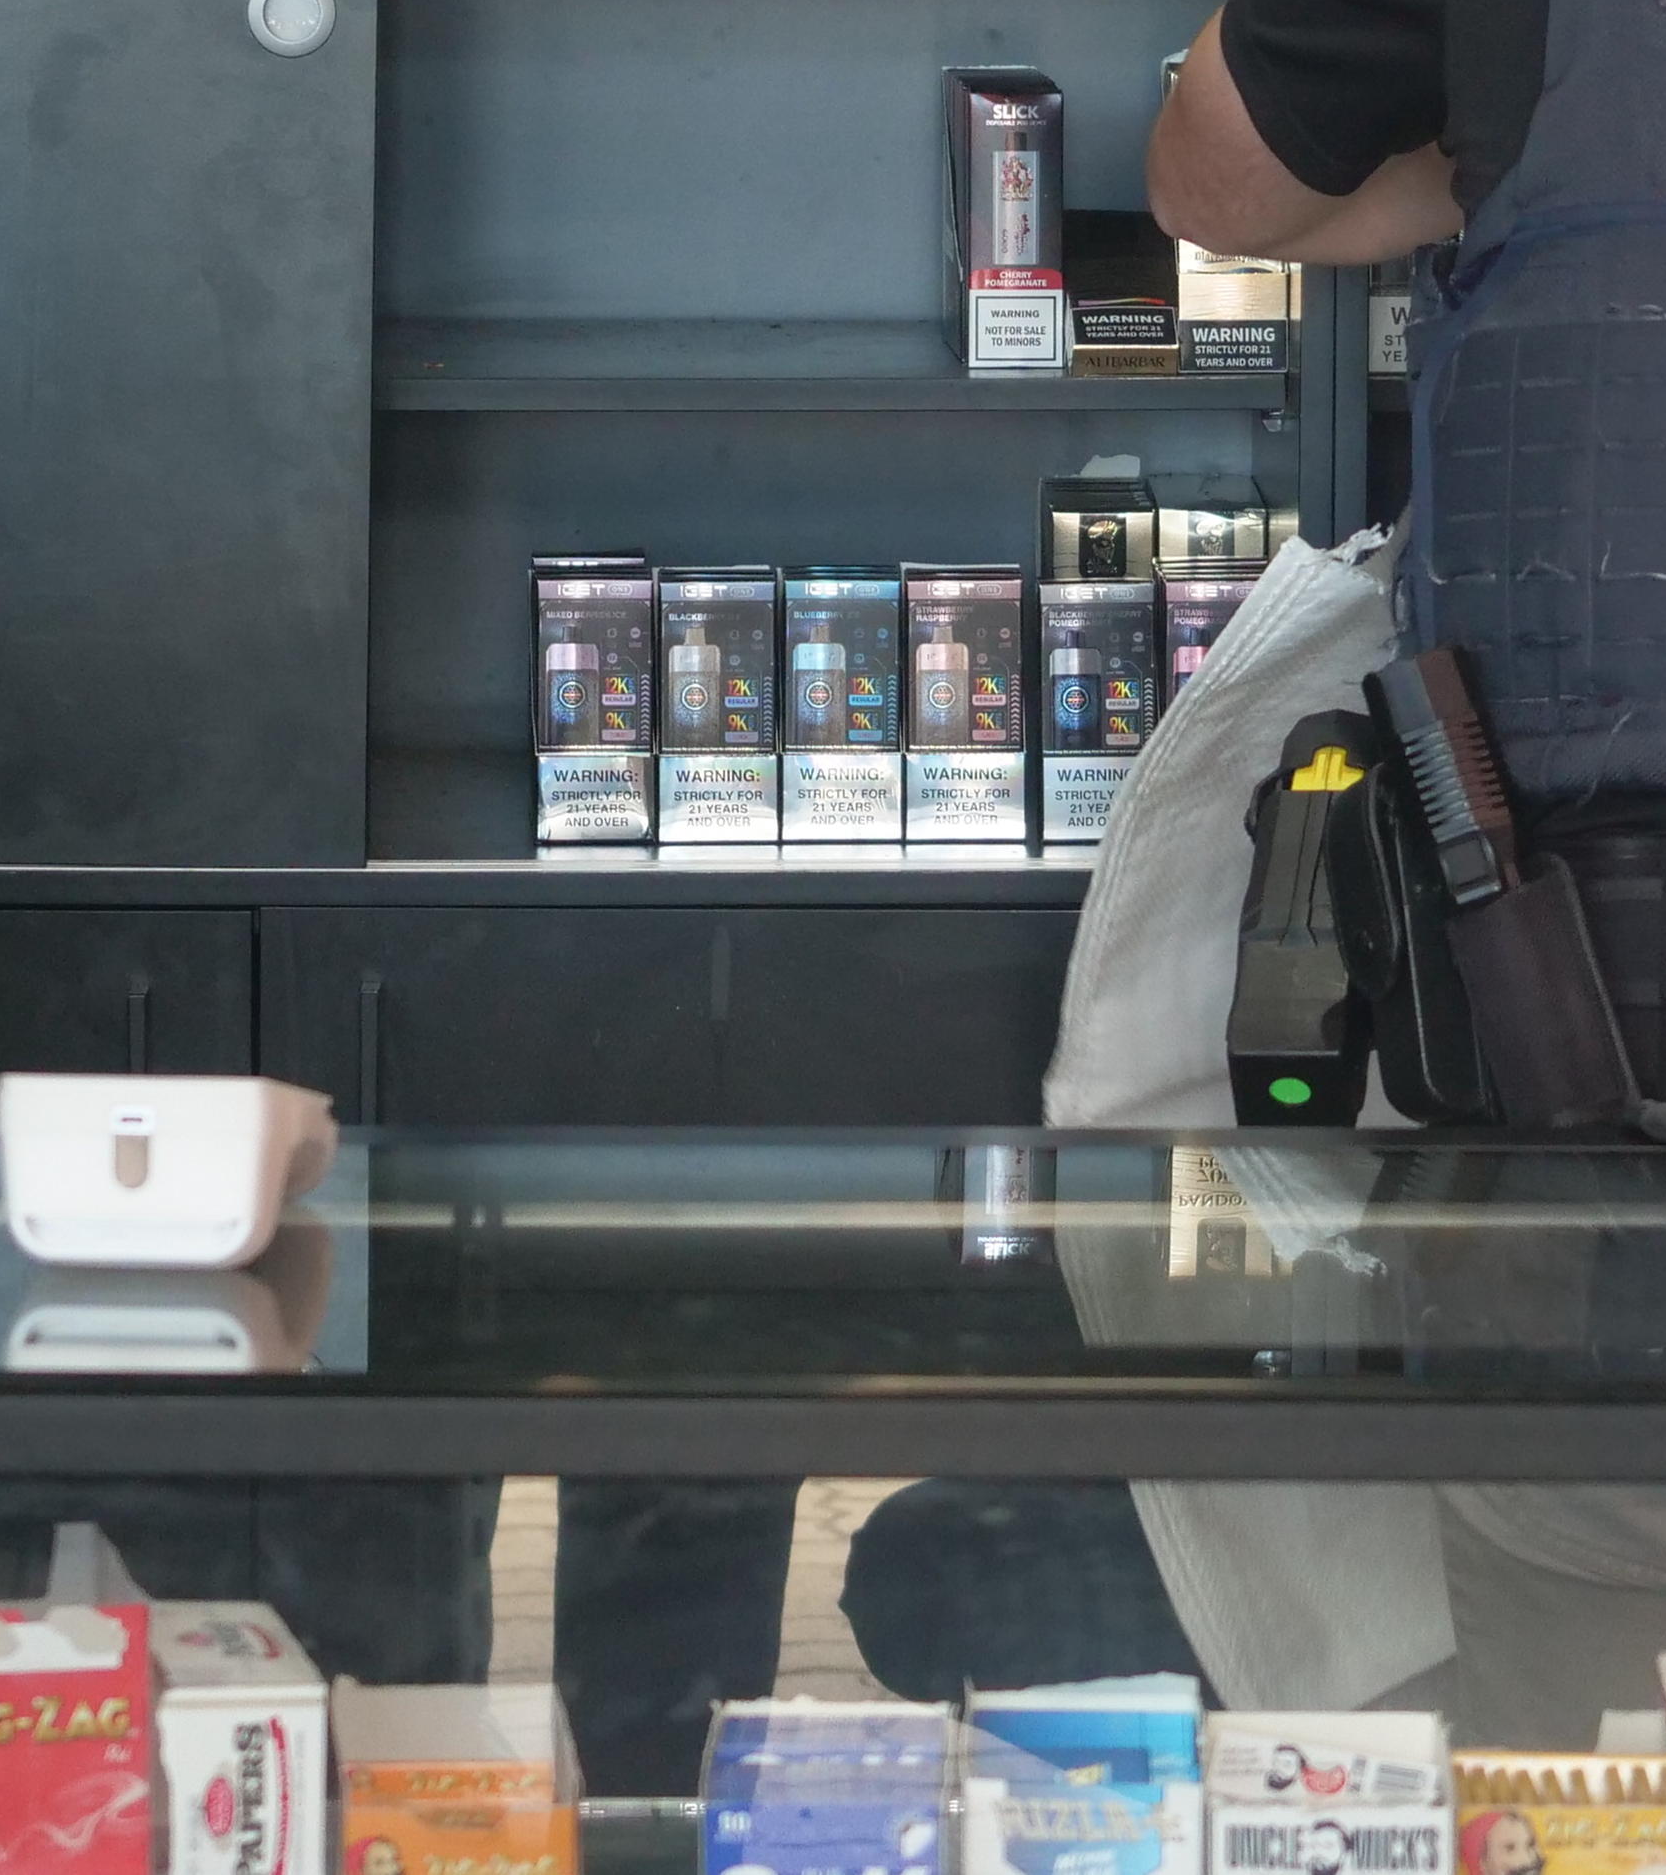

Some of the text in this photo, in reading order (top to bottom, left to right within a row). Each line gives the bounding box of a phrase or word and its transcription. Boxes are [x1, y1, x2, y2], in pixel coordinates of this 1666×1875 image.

[993, 104, 1039, 119] SLICK
[999, 271, 1033, 279] CHERRY
[984, 279, 1048, 287] POMEGRANATE
[990, 310, 1040, 318] WARNING
[1082, 315, 1165, 324] WARNING
[984, 326, 1047, 336] NOT FOR SALE
[1192, 327, 1276, 343] WARNING
[991, 337, 1042, 347] TO MINORS
[1195, 345, 1271, 355] STRICTLY FOR 21
[1195, 358, 1273, 367] YEARS AND OVER
[553, 769, 639, 783] WARNING:
[675, 769, 761, 783] WARNING:
[799, 767, 885, 781] WARNING:
[923, 767, 1008, 782] WARNING:
[551, 790, 642, 802] STRICTLY FOR
[673, 790, 764, 802] STRICTLY FOR
[797, 788, 887, 800] STRICTLY FOR
[921, 788, 1011, 800] STRICTLY FOR
[1055, 789, 1115, 800] STRICTLY
[566, 803, 627, 814] 21 YEARS
[688, 804, 748, 814] 21 YEARS
[812, 802, 872, 812] 21 YEARS
[935, 801, 995, 812] 21 YEARS
[1069, 803, 1111, 814] 21 YEA
[564, 816, 629, 827] AND OVER
[686, 816, 751, 828] AND OVER
[810, 815, 875, 826] AND OVER
[933, 815, 998, 825] AND OVER
[1067, 816, 1095, 827] AND
